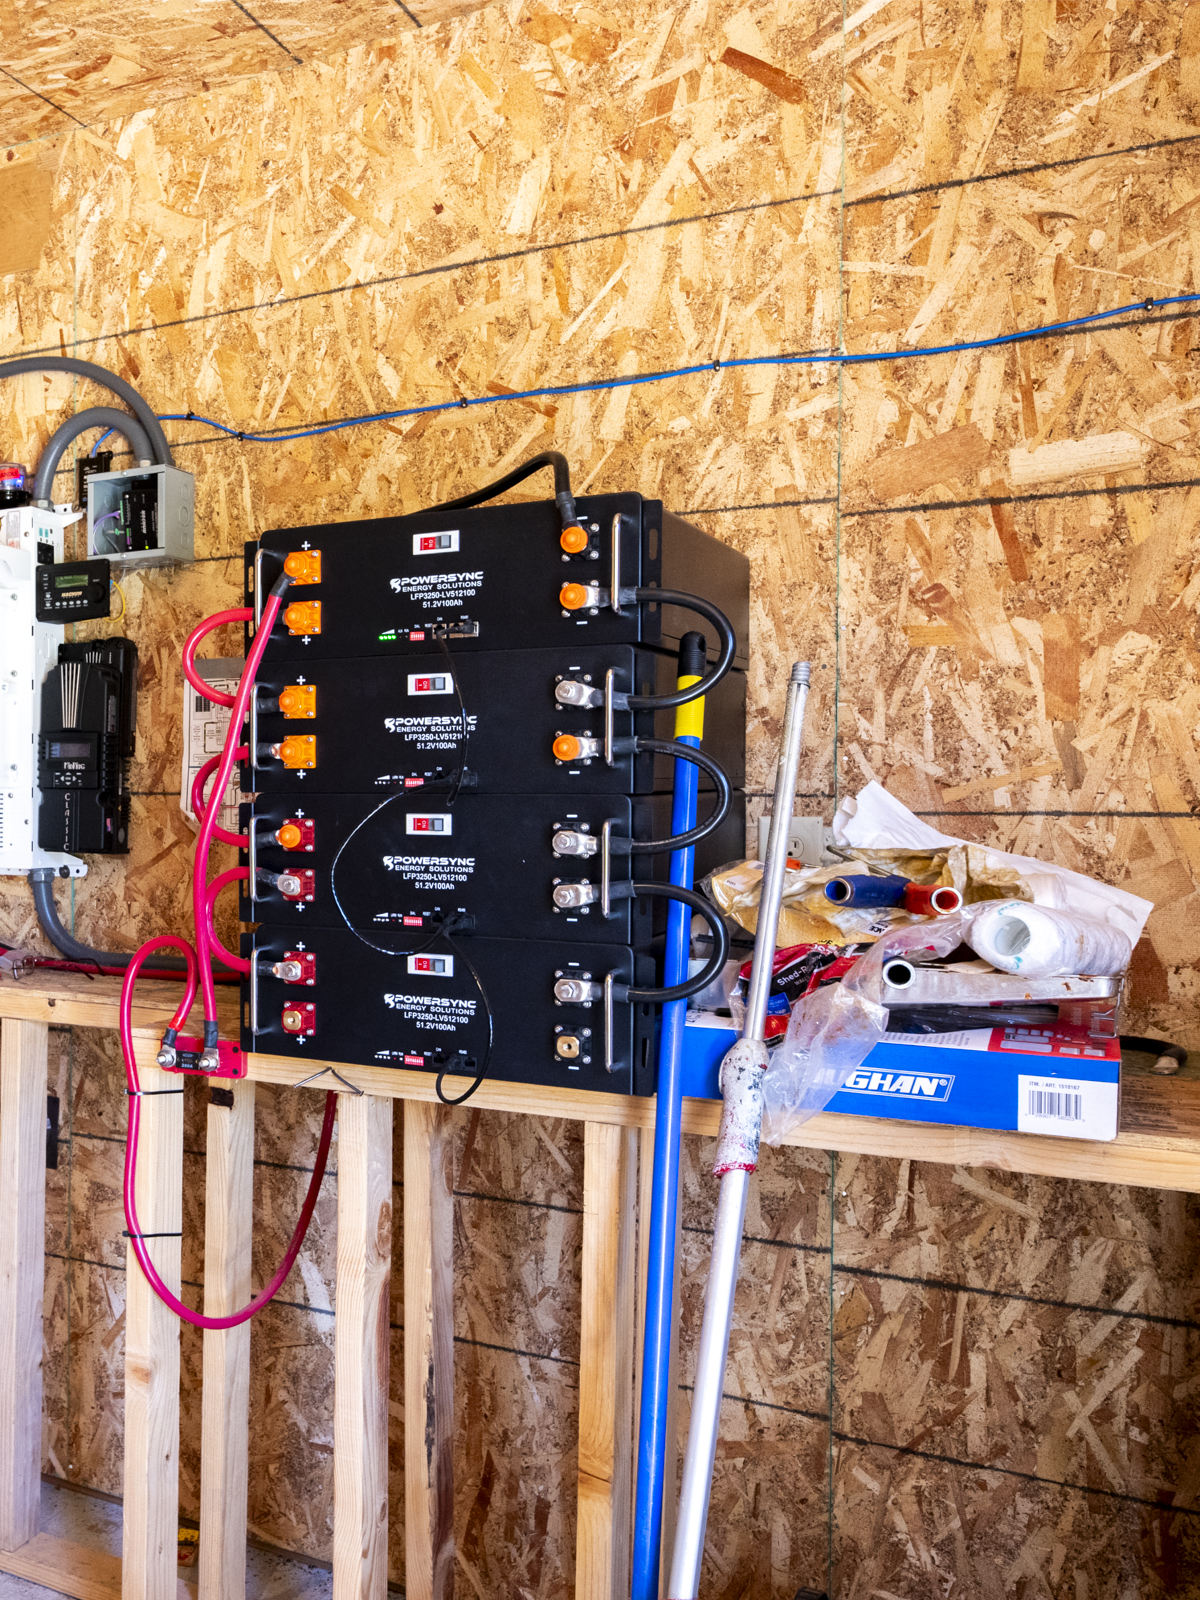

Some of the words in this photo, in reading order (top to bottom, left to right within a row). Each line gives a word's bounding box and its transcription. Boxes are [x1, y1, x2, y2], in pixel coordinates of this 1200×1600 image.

[400, 571, 484, 586] POWERSYNC
[402, 584, 433, 592] ENERGY
[436, 580, 482, 589] SOLUTIONS
[410, 589, 476, 600] LFP3250-LV512100
[422, 599, 463, 608] 51.2V100Ah
[416, 742, 457, 750] 51.2V100Ah
[394, 856, 476, 866] POWERSYNC
[403, 872, 468, 882] LFP3250-LV512100
[414, 882, 455, 890] 51.2V100Ah
[395, 994, 477, 1009] POWERSYNC
[396, 1003, 427, 1011] ENERGY
[430, 1006, 475, 1016] SOLUTIONS
[404, 1012, 469, 1024] LFP3250-LV512100
[416, 1021, 456, 1031] 51.2V100Ah
